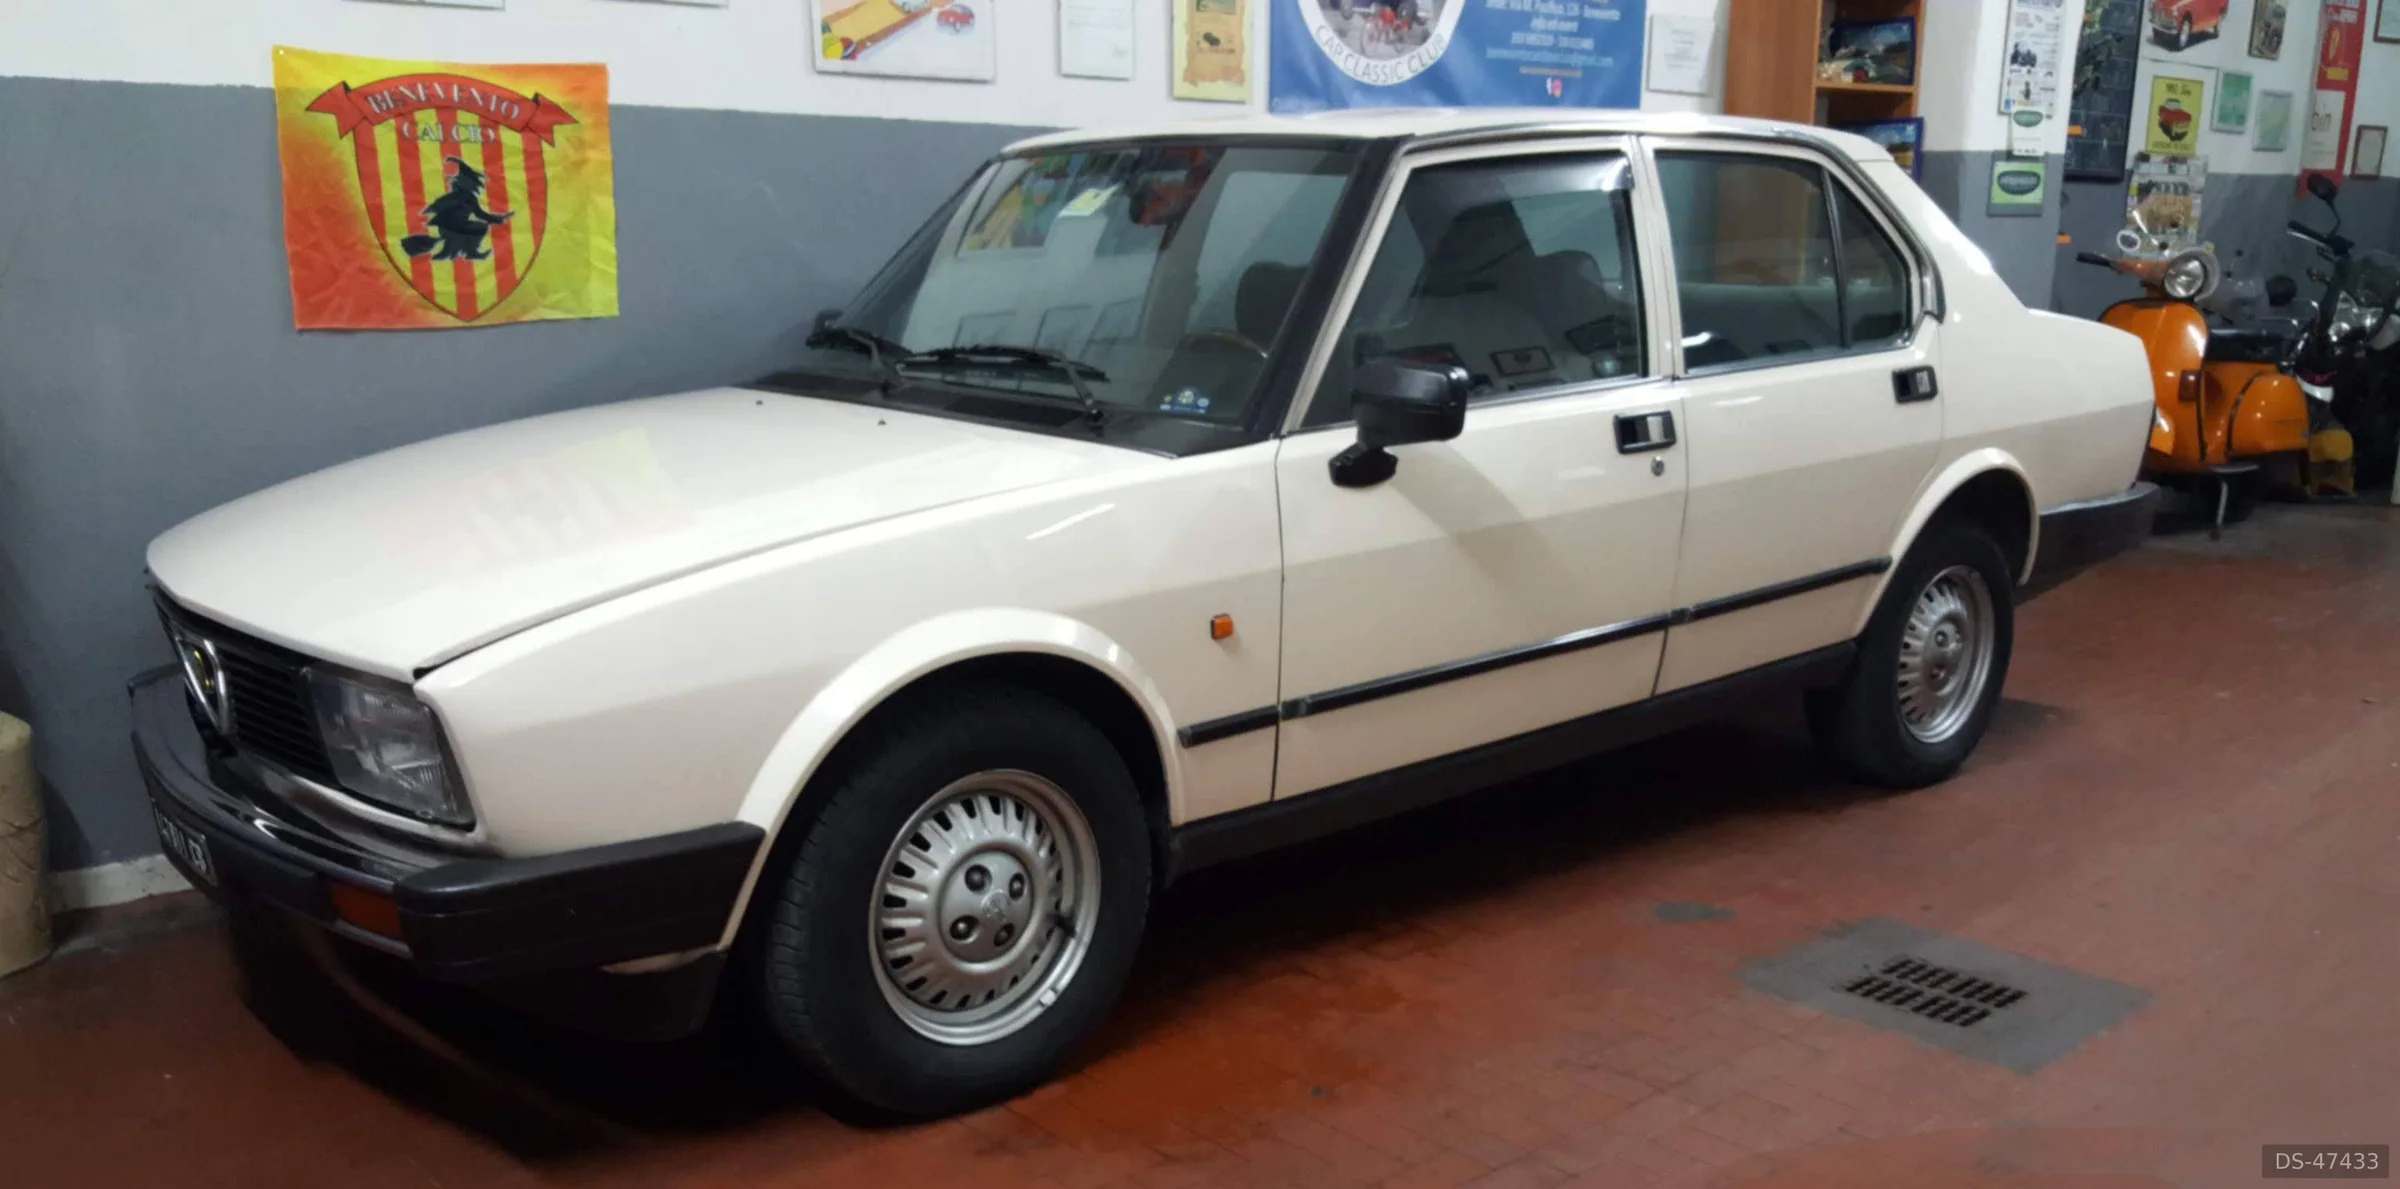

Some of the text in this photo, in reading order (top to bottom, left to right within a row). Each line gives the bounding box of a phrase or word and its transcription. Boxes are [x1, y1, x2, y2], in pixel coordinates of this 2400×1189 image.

[1344, 53, 1405, 83] CLASSIC
[366, 81, 520, 120] BENEVENTO
[402, 120, 496, 143] CALCIO
